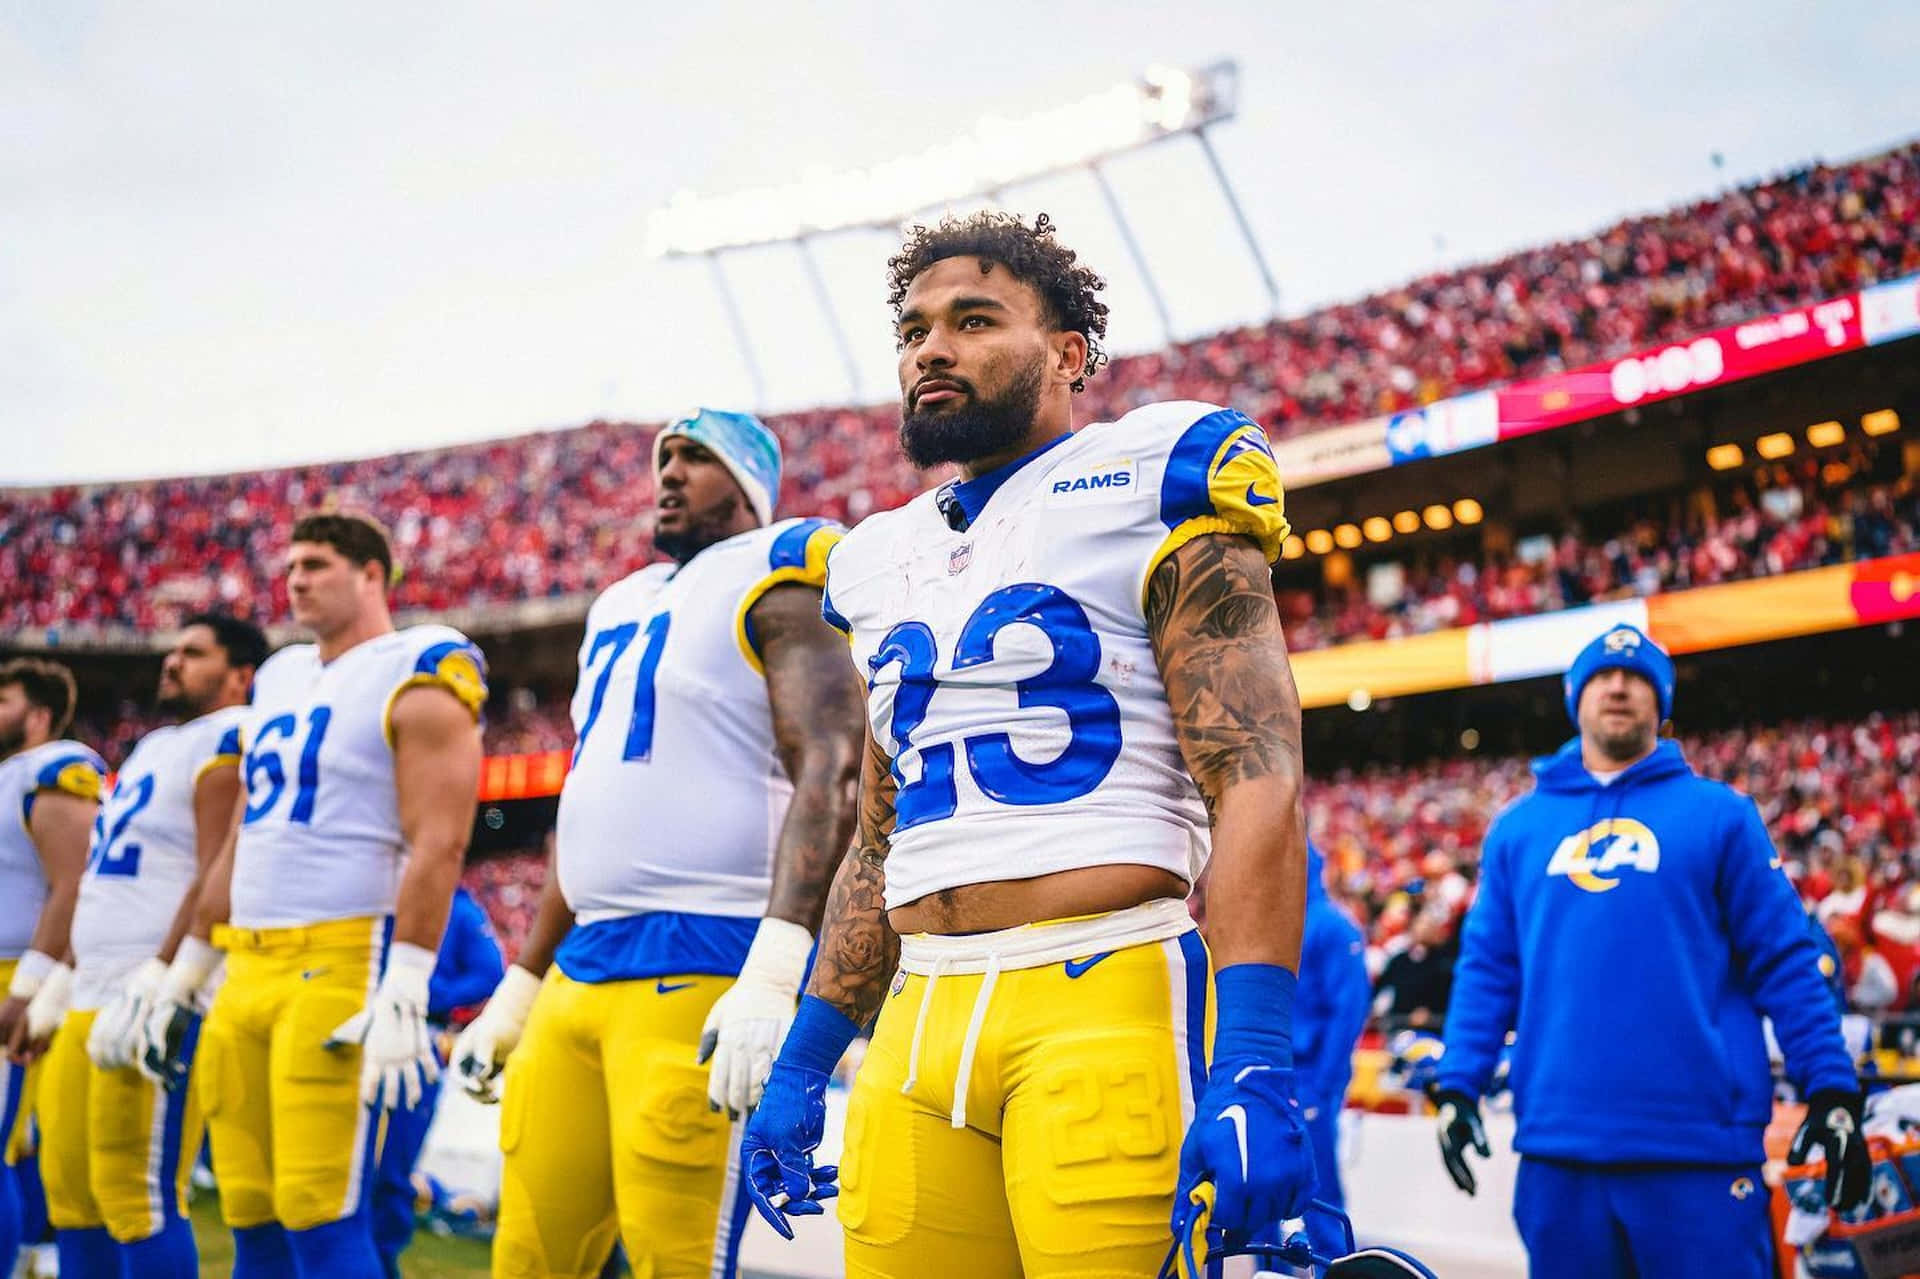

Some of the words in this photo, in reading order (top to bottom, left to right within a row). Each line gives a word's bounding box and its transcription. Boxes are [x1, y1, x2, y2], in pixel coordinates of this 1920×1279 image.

[1052, 471, 1131, 494] RAMS
[572, 611, 671, 771] 71
[867, 582, 1123, 834] 23
[243, 706, 332, 825] 61
[1046, 1060, 1169, 1169] 23
